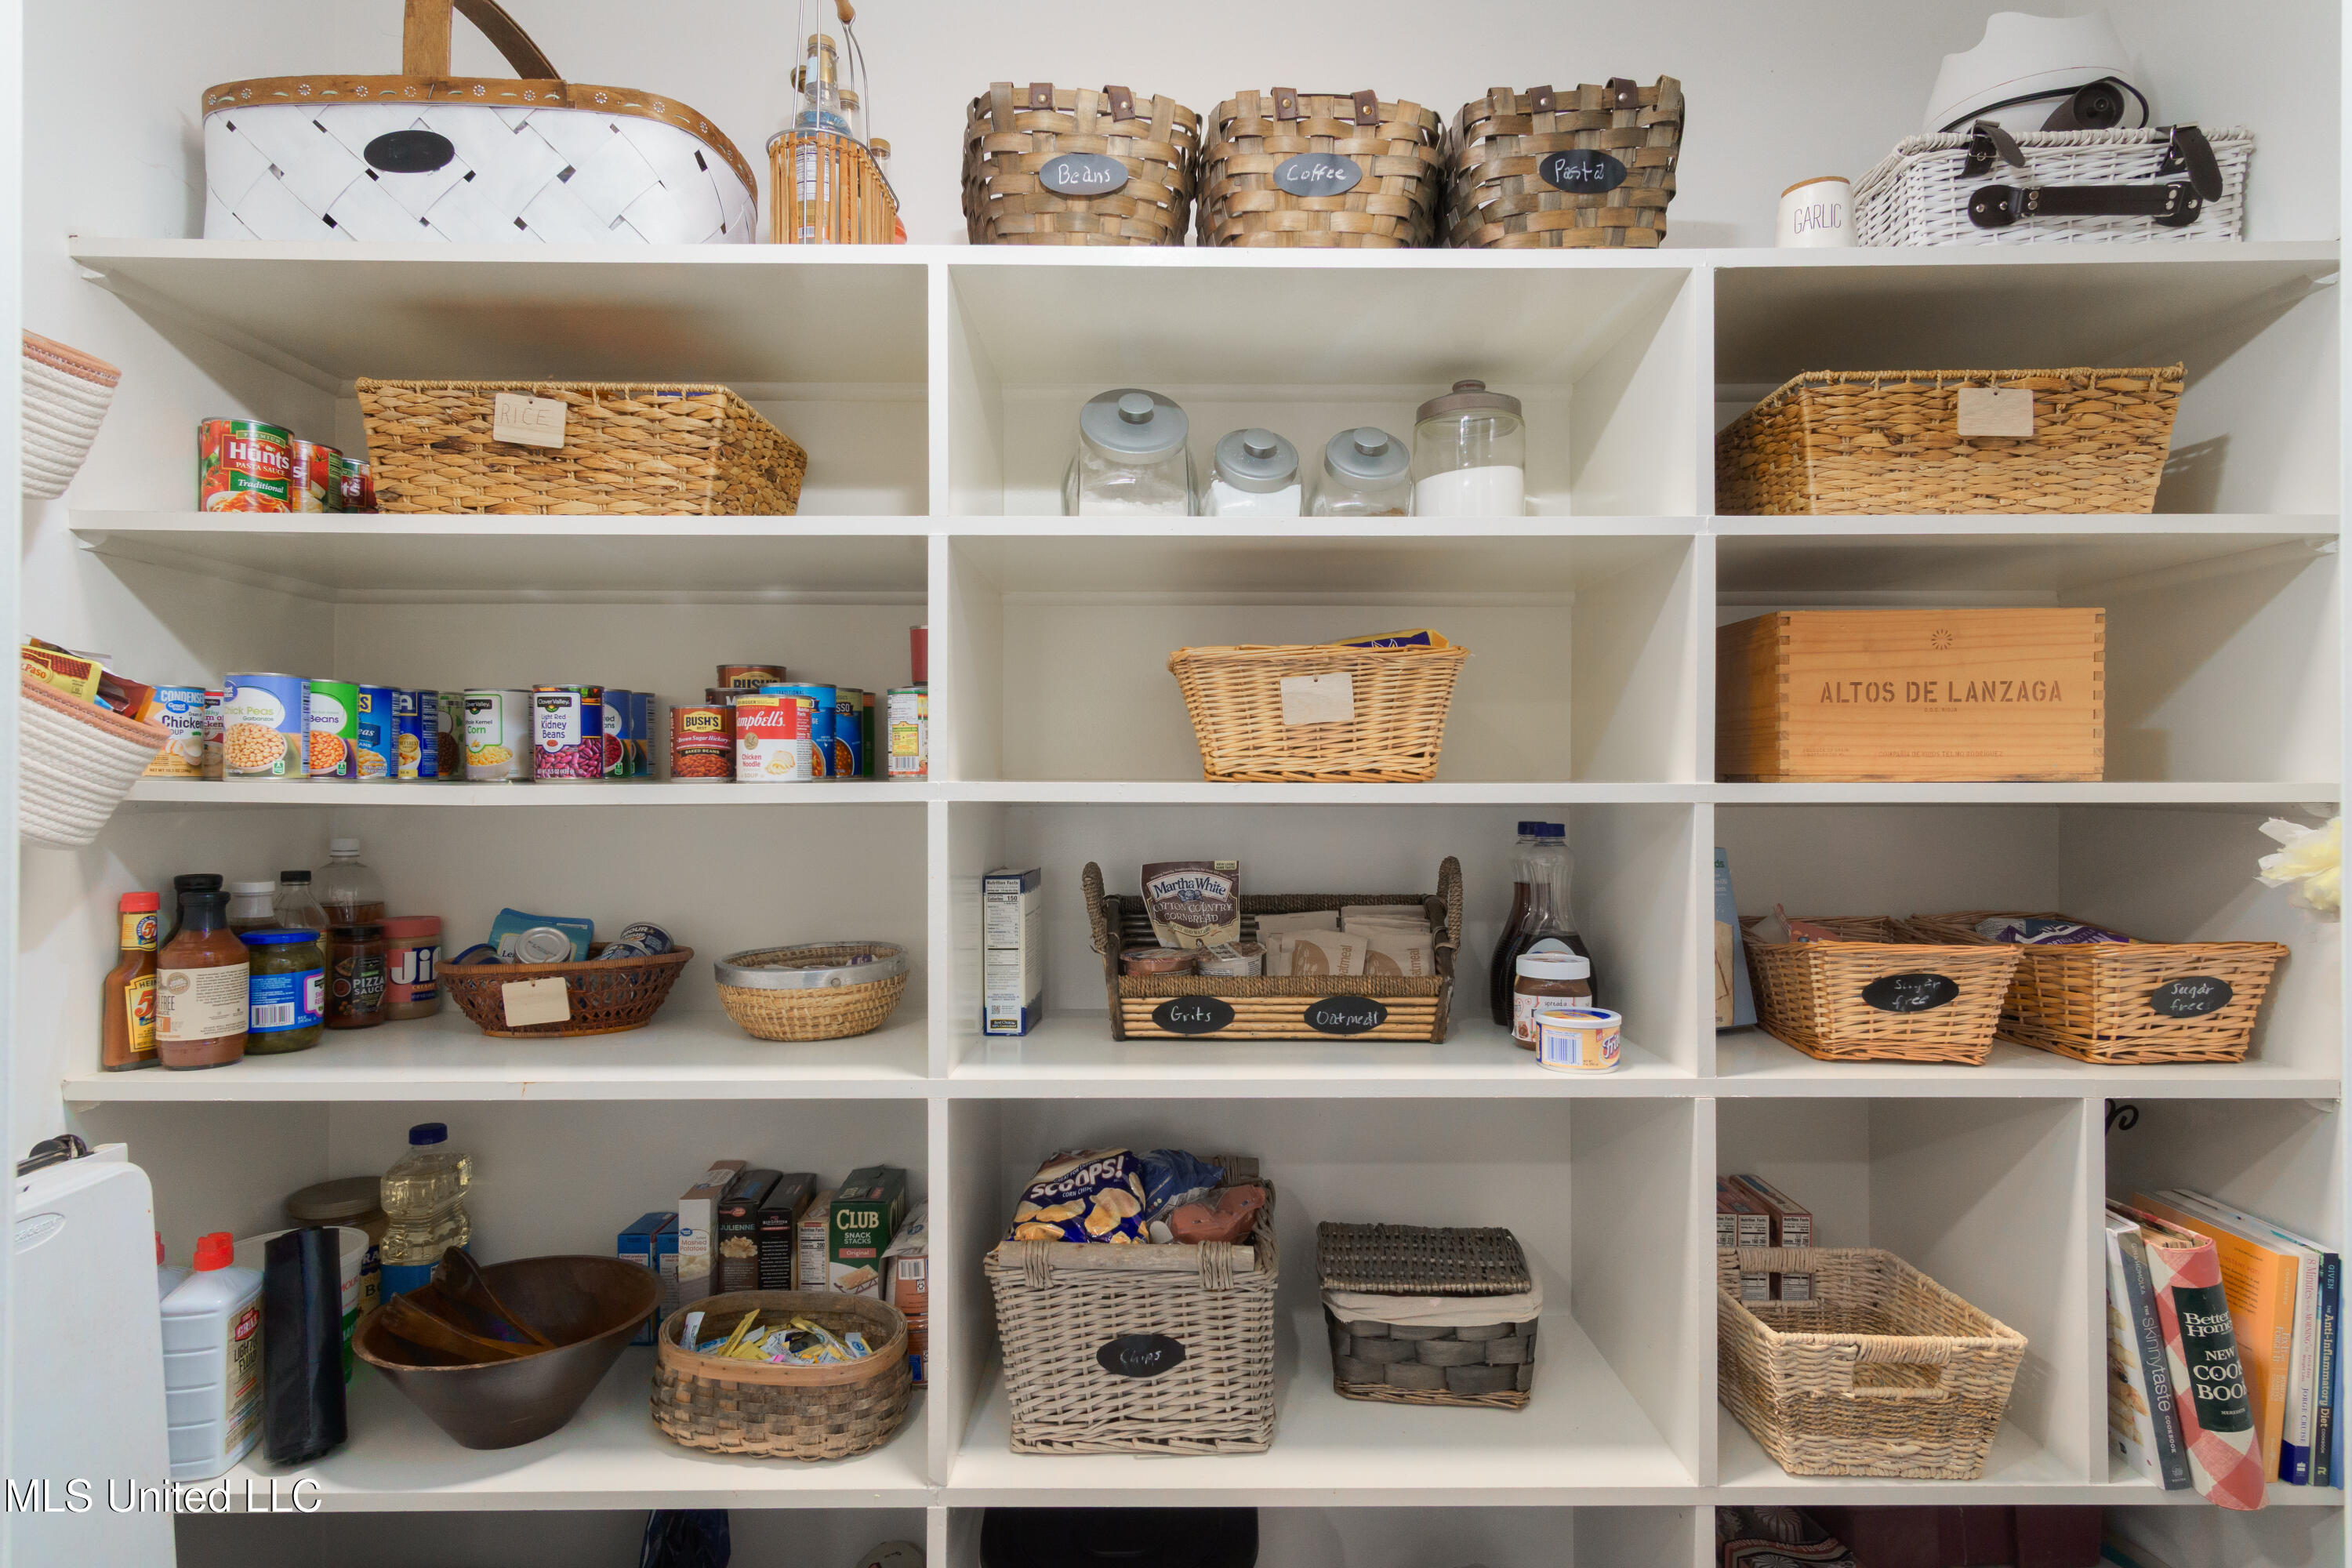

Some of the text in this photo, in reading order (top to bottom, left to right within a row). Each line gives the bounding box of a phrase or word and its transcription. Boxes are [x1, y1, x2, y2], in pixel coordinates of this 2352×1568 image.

[1058, 163, 1110, 185] Beans
[1287, 163, 1348, 183] Coffee
[1555, 158, 1605, 183] Pasta
[1794, 203, 1842, 234] GARLIC
[500, 403, 552, 426] RICE
[244, 432, 281, 444] PREMIUM
[230, 441, 290, 470] Hunt's
[236, 462, 261, 472] PASTA
[263, 465, 285, 477] SAUCE
[238, 478, 284, 495] Traditional
[24, 662, 46, 679] Paso
[1820, 680, 2063, 703] ALTOS DE LANZAGA
[246, 706, 274, 716] Peas
[541, 720, 567, 731] Kidney
[685, 717, 719, 728] BUSH'S
[736, 711, 784, 730] ampbell's
[543, 730, 565, 739] Beans
[708, 735, 728, 744] Hickory
[1153, 877, 1226, 898] Martha White
[1153, 902, 1233, 913] COTTON COUNTRY
[1164, 913, 1218, 924] CORNBREAD
[390, 946, 441, 985] Jif
[353, 976, 385, 989] PIZZA
[354, 985, 384, 996] SAUCE
[2170, 982, 2214, 998] Sugar
[162, 996, 176, 1011] FREE
[1544, 1000, 1563, 1008] spread
[1892, 994, 1926, 1011] free
[2169, 999, 2205, 1011] free
[1171, 1005, 1211, 1022] Grits
[1316, 1011, 1379, 1026] Oatmeal
[1029, 1155, 1125, 1199] SCOOPS!
[1069, 1167, 1079, 1176] FOR
[1078, 1185, 1093, 1196] CHIPS
[837, 1209, 880, 1230] CLUB
[2134, 1261, 2146, 1295] HOMOLKA
[2304, 1266, 2316, 1299] Minutes
[2183, 1310, 2230, 1326] Better
[2303, 1314, 2313, 1344] MORNING
[238, 1348, 257, 1373] FLUID
[1120, 1348, 1162, 1366] Chips
[2205, 1345, 2234, 1361] NEW
[2319, 1314, 2333, 1406] Anti-Inflammatory
[2142, 1316, 2171, 1412] skinnytaste
[2164, 1415, 2176, 1454] COOKBOOK
[2299, 1387, 2310, 1443] JORGE CRUISE
[2319, 1408, 2329, 1427] Diet
